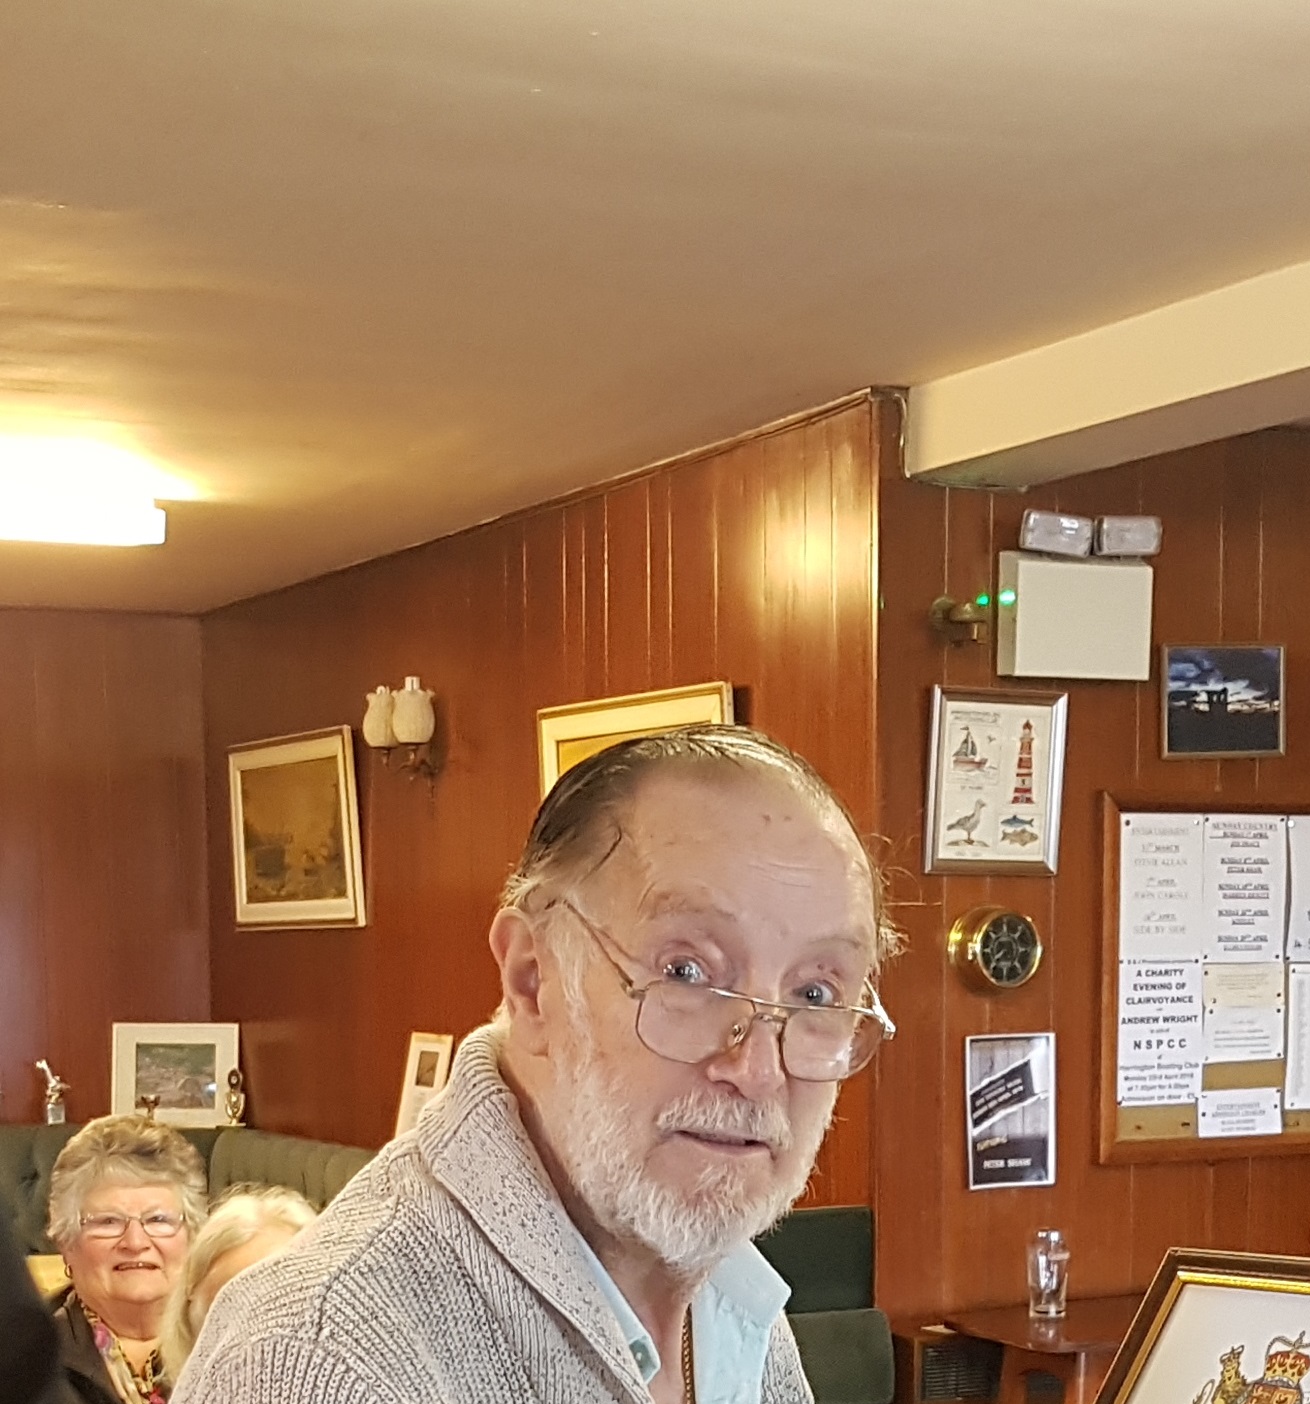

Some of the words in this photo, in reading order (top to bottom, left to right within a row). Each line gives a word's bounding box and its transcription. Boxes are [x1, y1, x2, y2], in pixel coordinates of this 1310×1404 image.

[1144, 968, 1184, 977] CHARITY
[1132, 982, 1173, 991] EVENING
[1175, 982, 1187, 990] OF
[1125, 995, 1194, 1006] CLAIRVOYANCE
[1120, 1016, 1160, 1025] ANDREW
[1162, 1015, 1199, 1024] WRIGHT
[1183, 1061, 1200, 1069] Club
